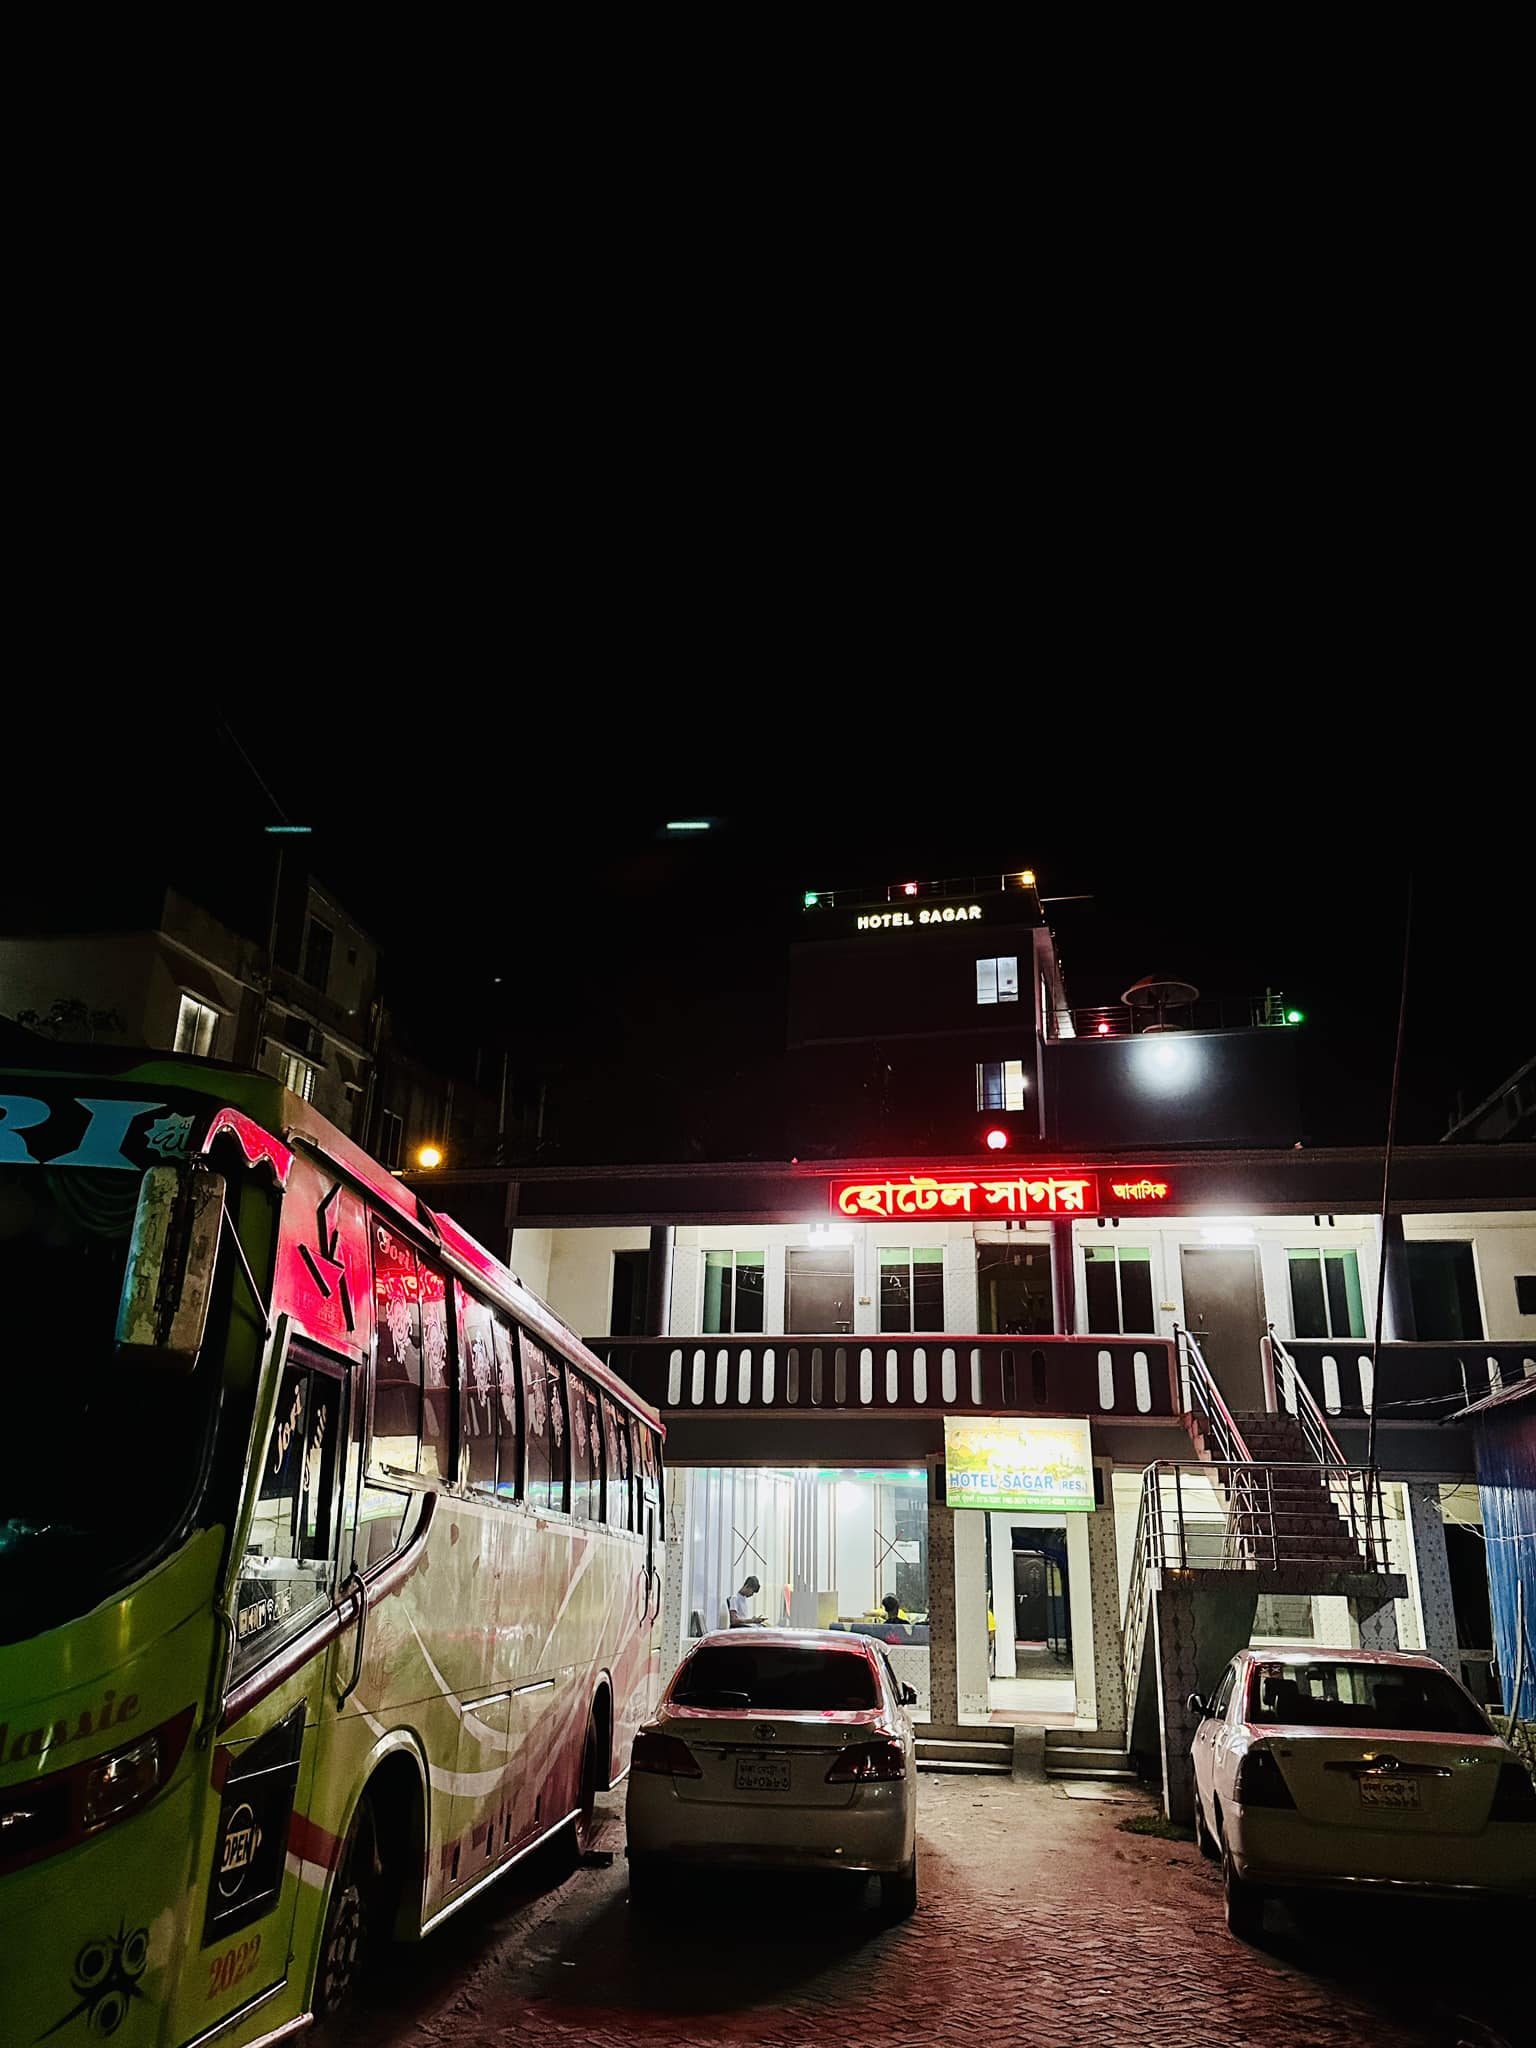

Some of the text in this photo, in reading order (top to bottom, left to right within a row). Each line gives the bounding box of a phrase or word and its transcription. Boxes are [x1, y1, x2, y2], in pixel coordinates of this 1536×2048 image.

[857, 905, 982, 930] HOTEL SAGAR
[838, 1175, 1090, 1216] হোটেল সাগর
[1112, 1179, 1168, 1200] আবাসিক
[949, 1472, 998, 1488] HOTEL
[1003, 1473, 1054, 1490] SAGAR
[220, 1829, 252, 1870] OPEN
[207, 1933, 262, 2001] 2022
